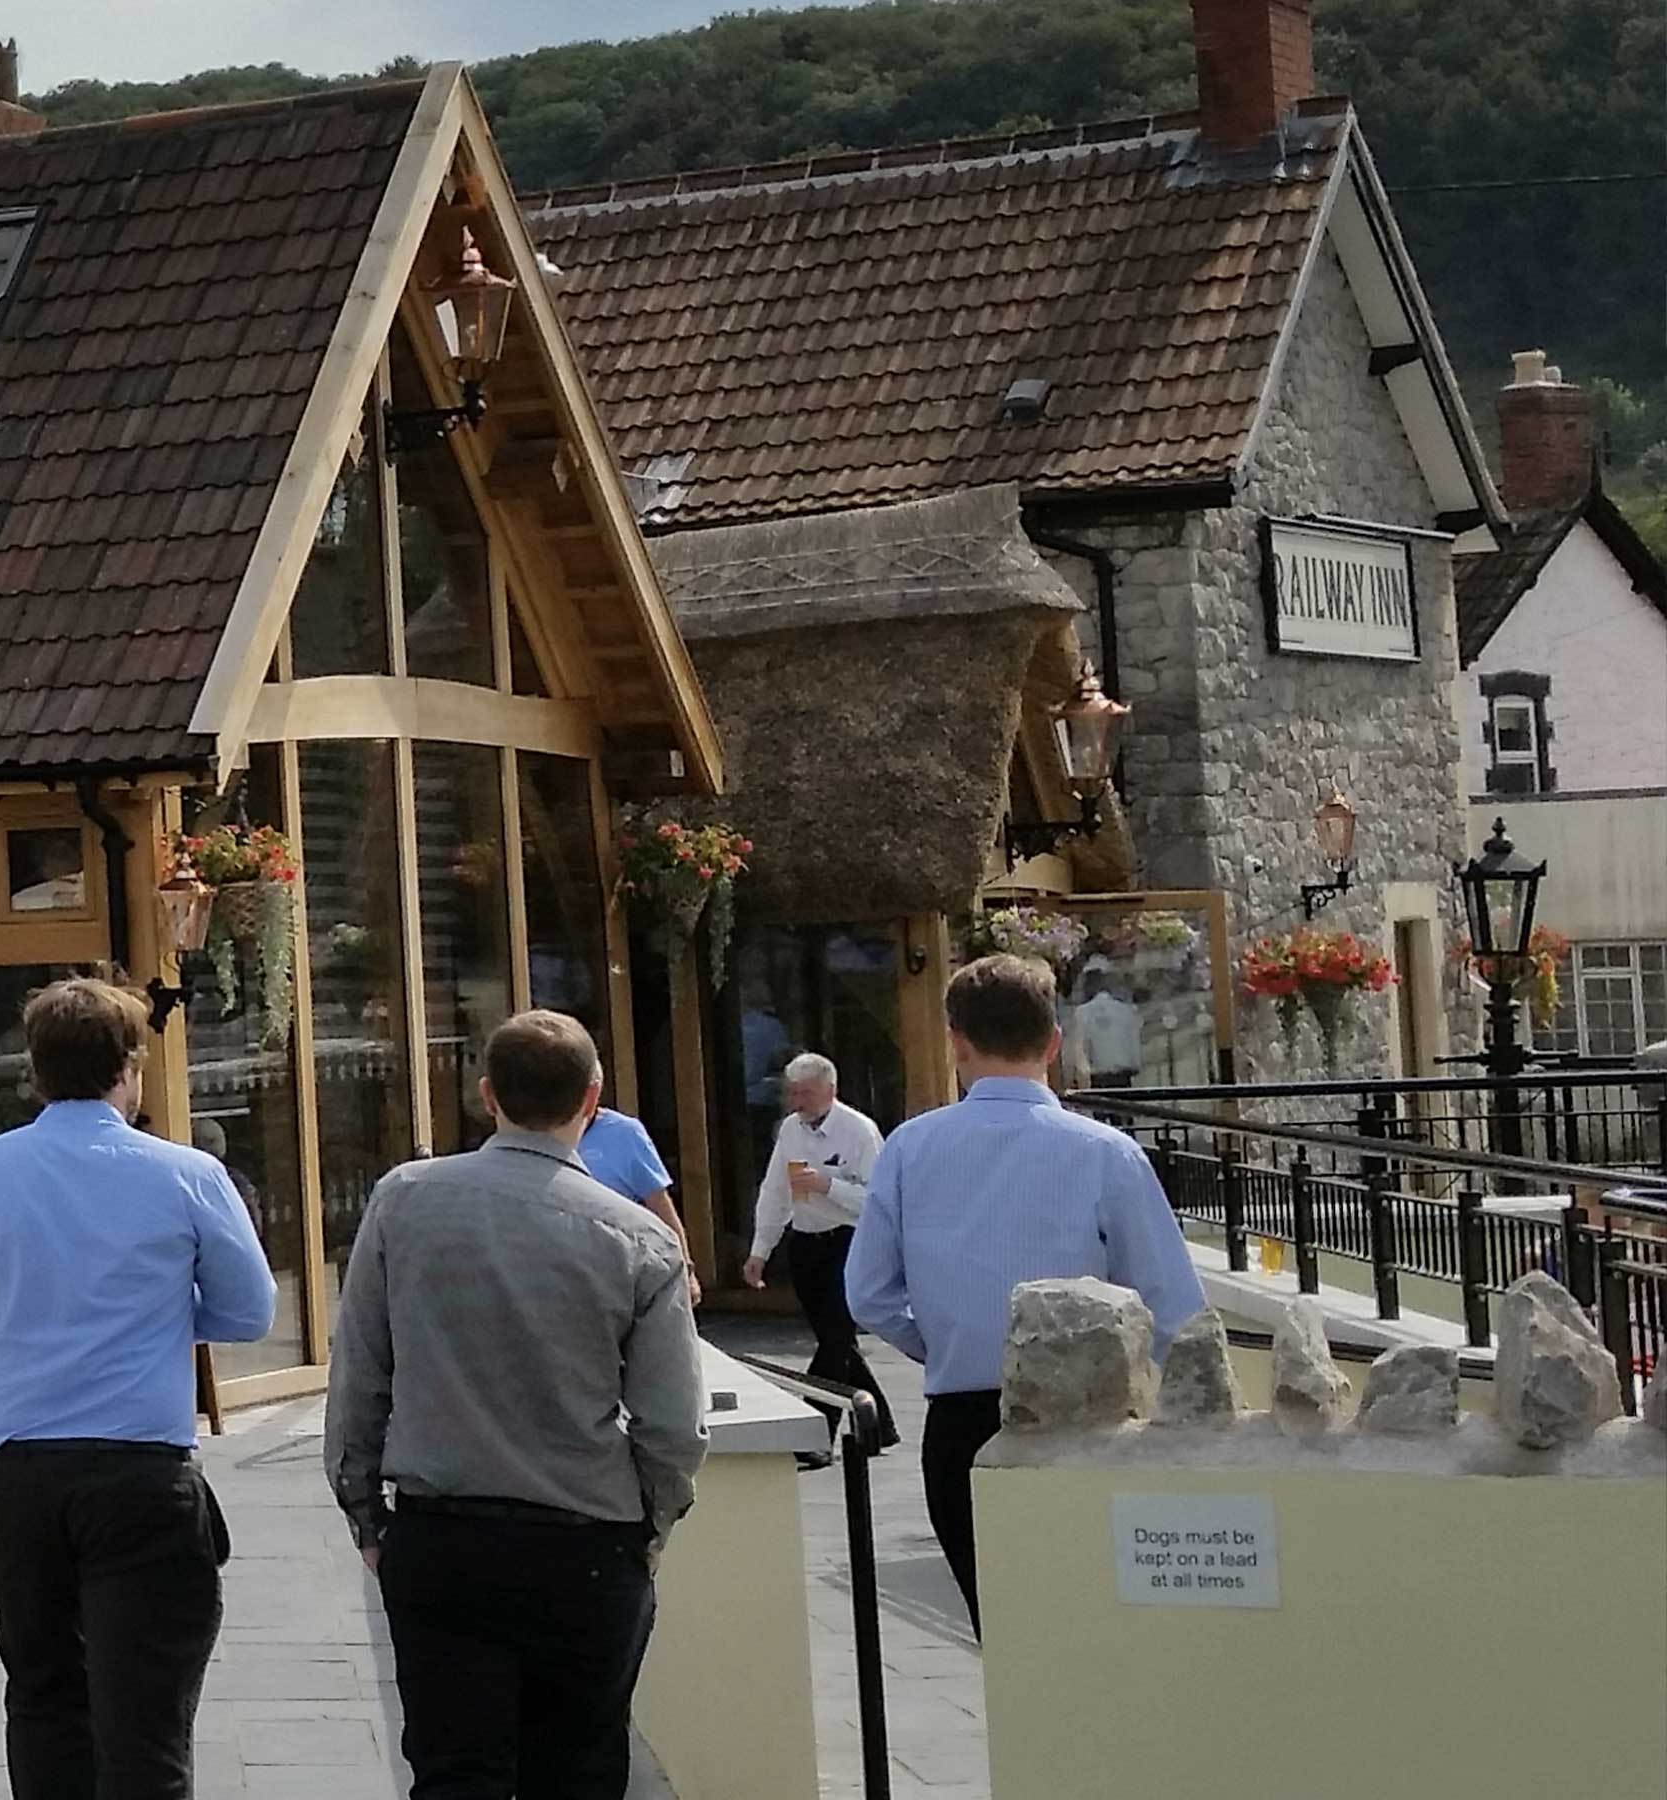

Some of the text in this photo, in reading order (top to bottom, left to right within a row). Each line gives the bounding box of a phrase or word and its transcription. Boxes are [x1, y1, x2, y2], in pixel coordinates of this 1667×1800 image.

[1273, 552, 1408, 628] RAILWAY INN
[1134, 1527, 1255, 1548] Dogs must be
[1134, 1550, 1258, 1568] kept on a lead
[1150, 1572, 1245, 1589] at all times
